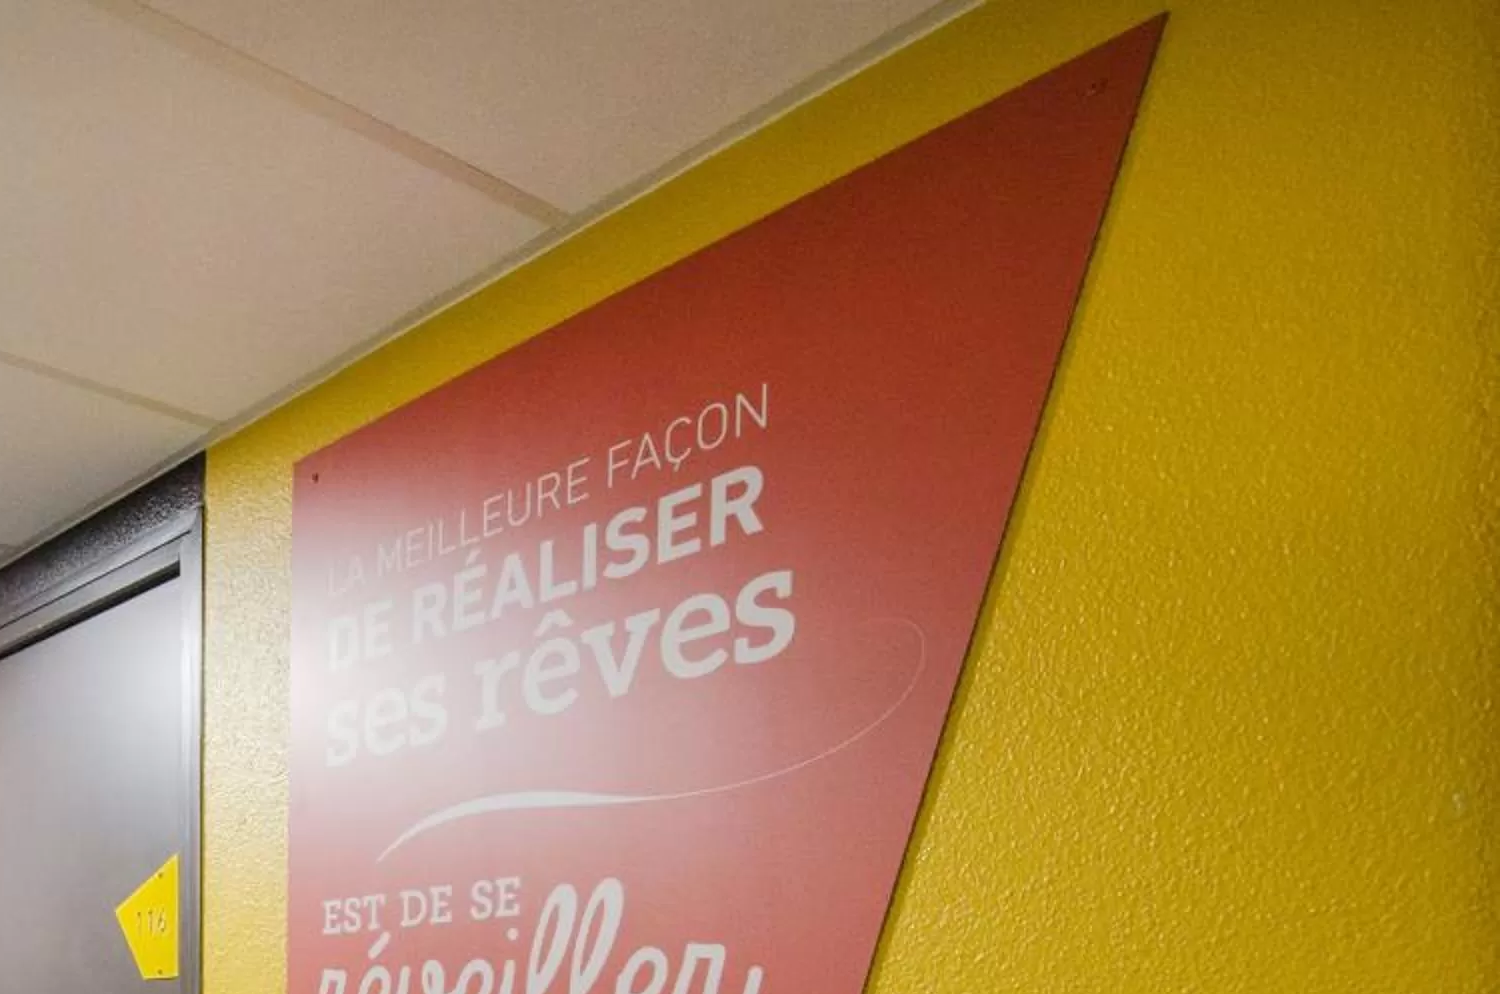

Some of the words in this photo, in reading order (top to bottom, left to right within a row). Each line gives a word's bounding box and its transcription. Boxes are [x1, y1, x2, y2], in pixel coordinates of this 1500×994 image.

[327, 546, 370, 596] LA
[376, 456, 591, 574] MEILLEURE
[607, 382, 769, 490] FAÇON
[327, 598, 393, 674] DE
[411, 464, 767, 645] RÉALISER
[325, 673, 448, 768] ses
[473, 570, 797, 734] rêves
[321, 893, 387, 936] EST
[399, 884, 454, 927] DE
[470, 876, 521, 920] SE
